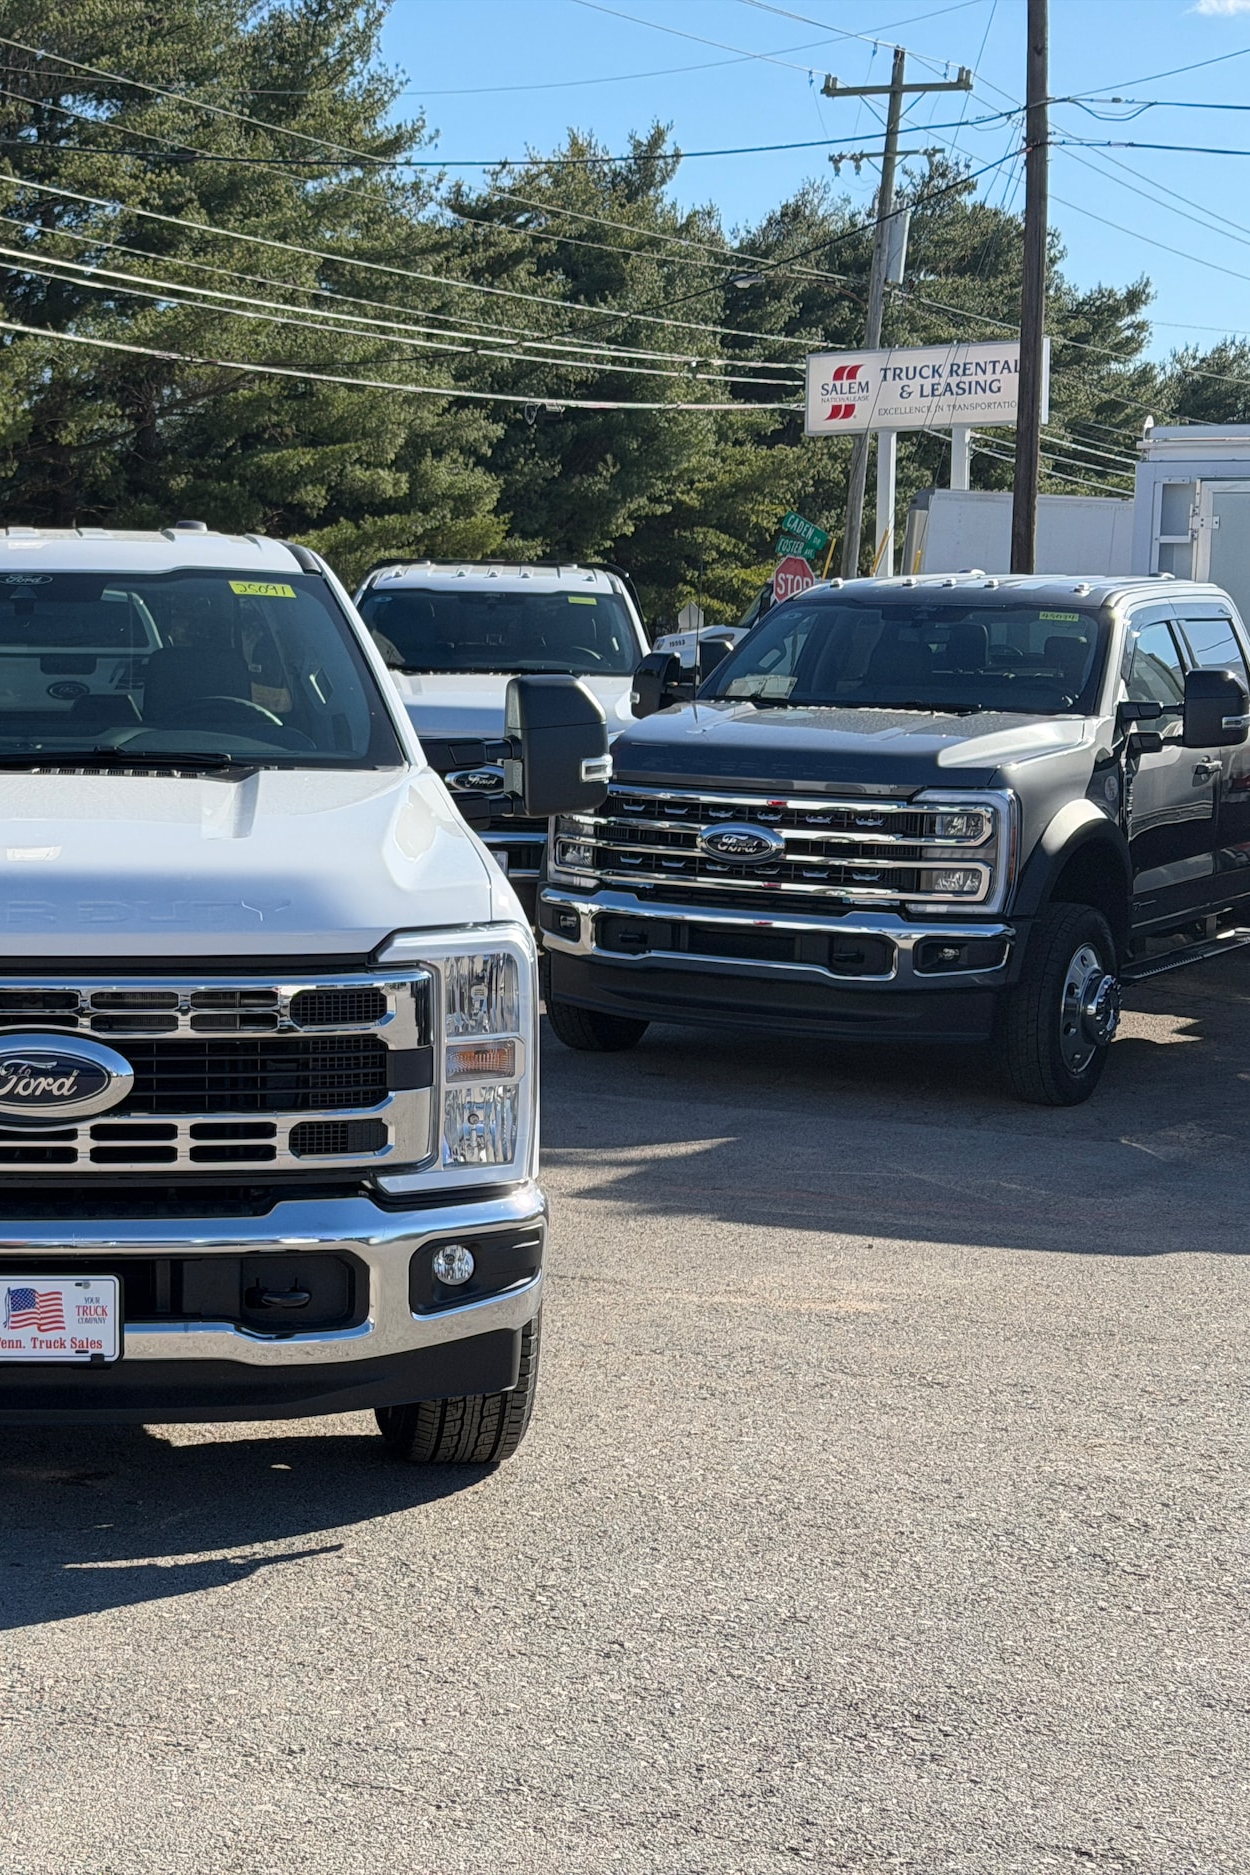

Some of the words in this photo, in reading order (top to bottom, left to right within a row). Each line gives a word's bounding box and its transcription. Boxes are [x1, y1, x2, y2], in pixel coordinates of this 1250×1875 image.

[880, 364, 943, 382] TRUCK
[950, 359, 1020, 377] RENTAL
[821, 381, 869, 396] SALEM
[899, 384, 914, 399] &
[919, 379, 1001, 398] LEASING
[821, 395, 869, 404] NATIONALEASE
[878, 404, 933, 416] EXCELLENCE
[934, 404, 944, 413] IN
[947, 399, 1017, 412] TRANSPORTATIO
[786, 514, 815, 540] CADEN
[464, 773, 498, 788] Ford
[717, 833, 758, 853] Ford
[76, 899, 291, 924] DUTY
[84, 1296, 100, 1304] YOUR
[76, 1305, 108, 1316] TRUCK
[30, 1336, 67, 1349] Truck
[70, 1336, 103, 1349] Sales
